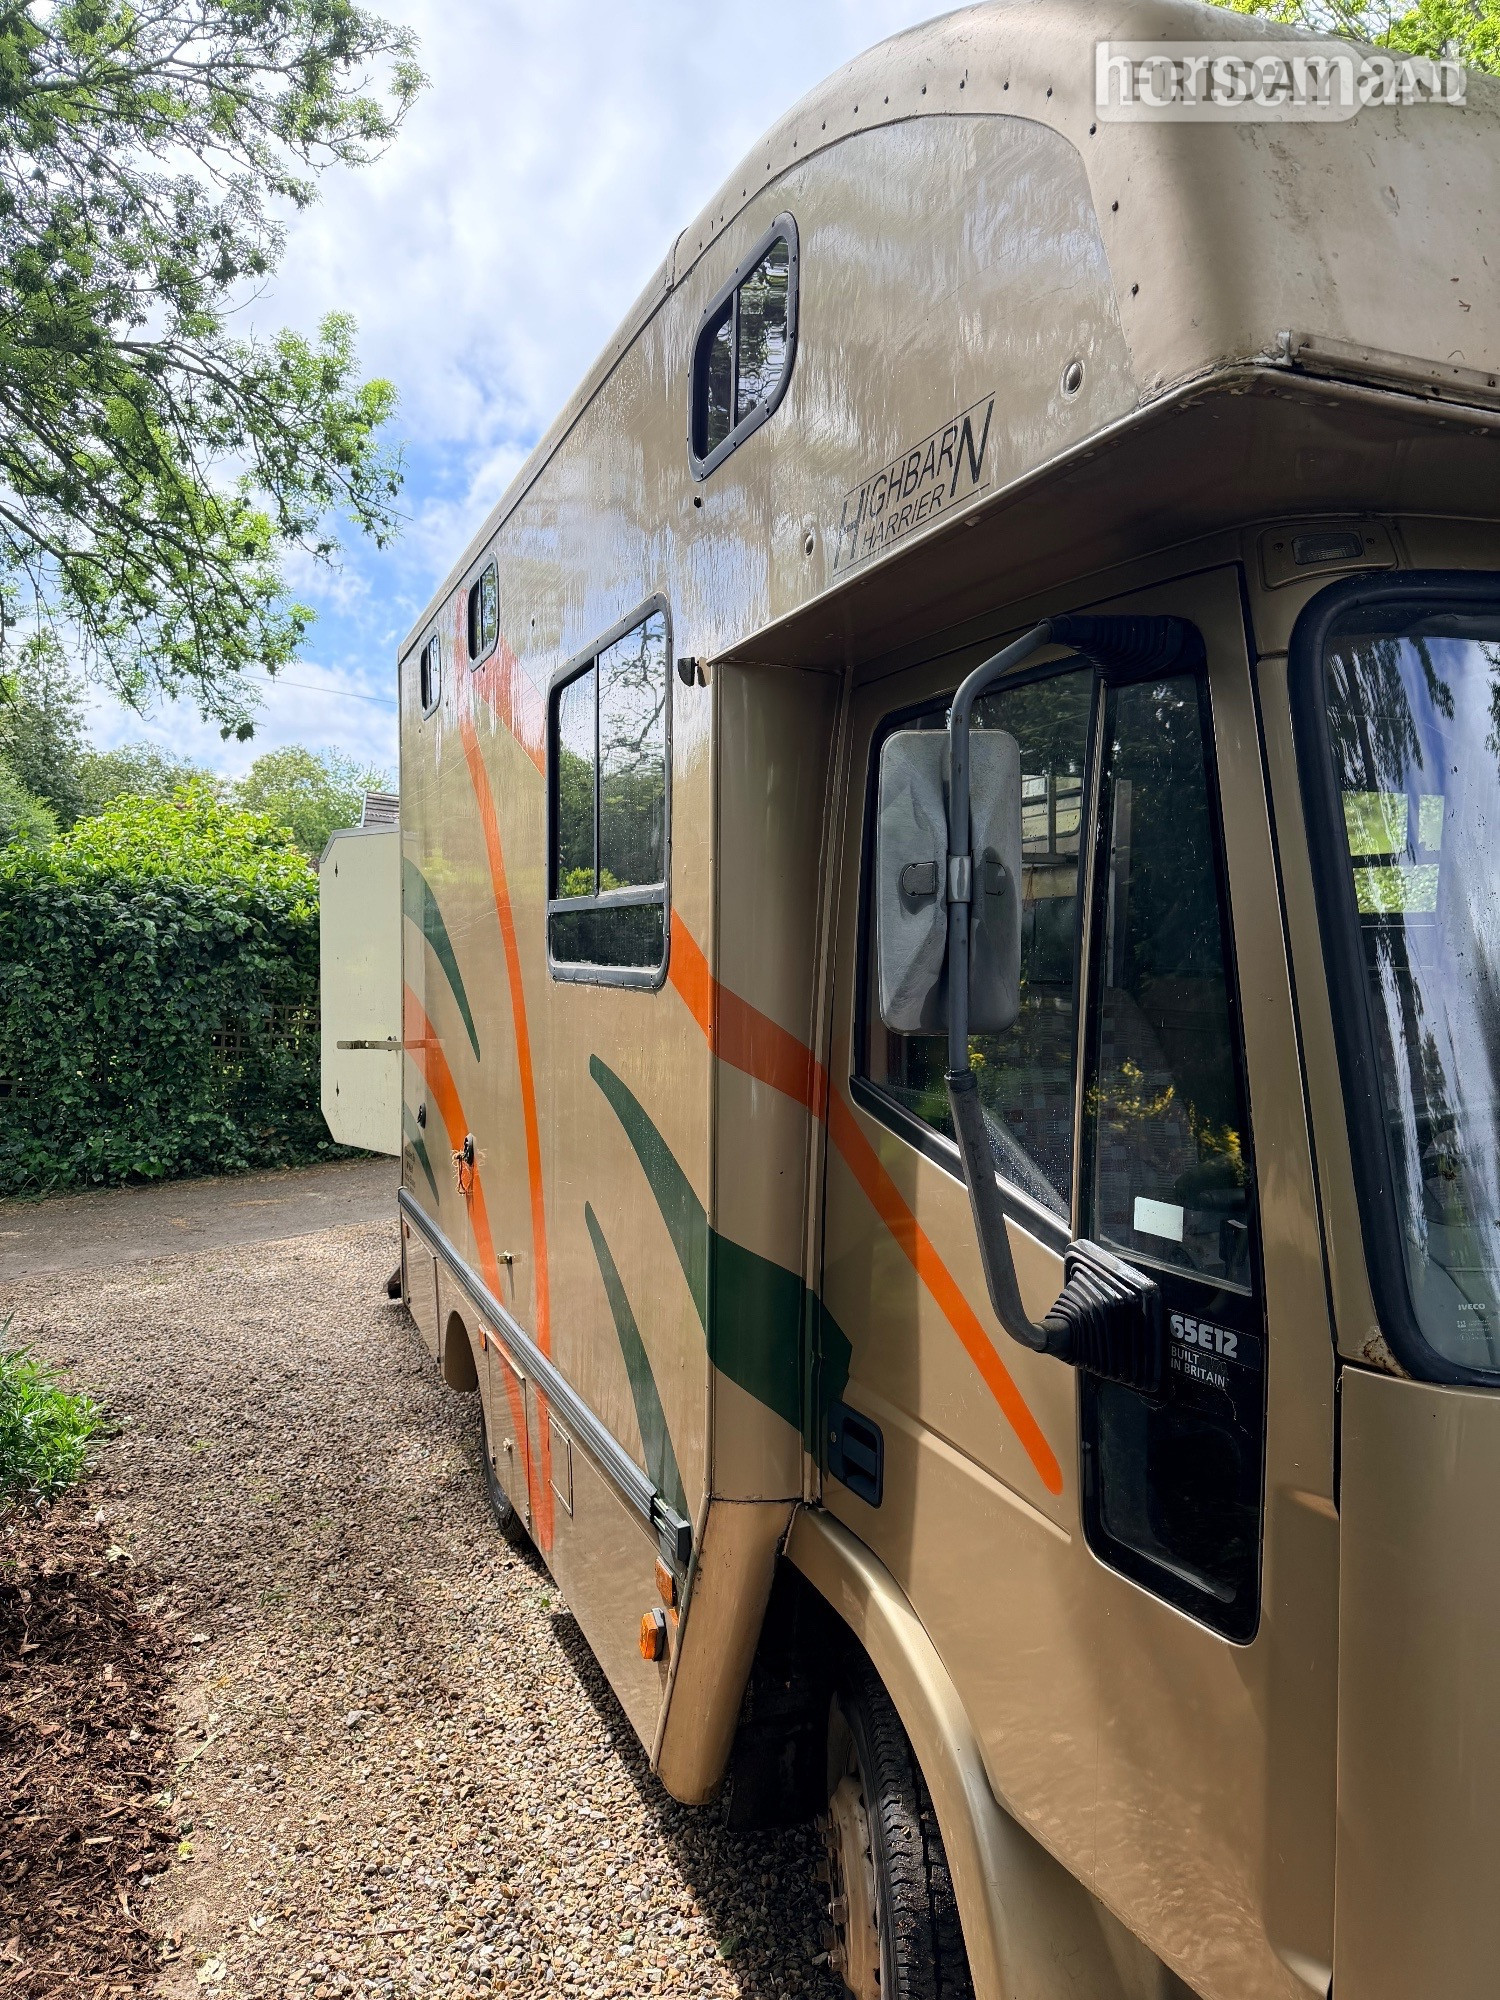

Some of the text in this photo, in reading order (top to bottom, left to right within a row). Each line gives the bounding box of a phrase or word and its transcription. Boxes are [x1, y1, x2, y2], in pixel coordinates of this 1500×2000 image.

[834, 398, 995, 570] HIGHBARN
[861, 483, 946, 554] HARRIER
[1458, 1303, 1486, 1311] IVECO
[1169, 1314, 1238, 1359] 65E12
[1171, 1345, 1200, 1365] BUILT
[1170, 1357, 1226, 1388] IN BRITAIN
